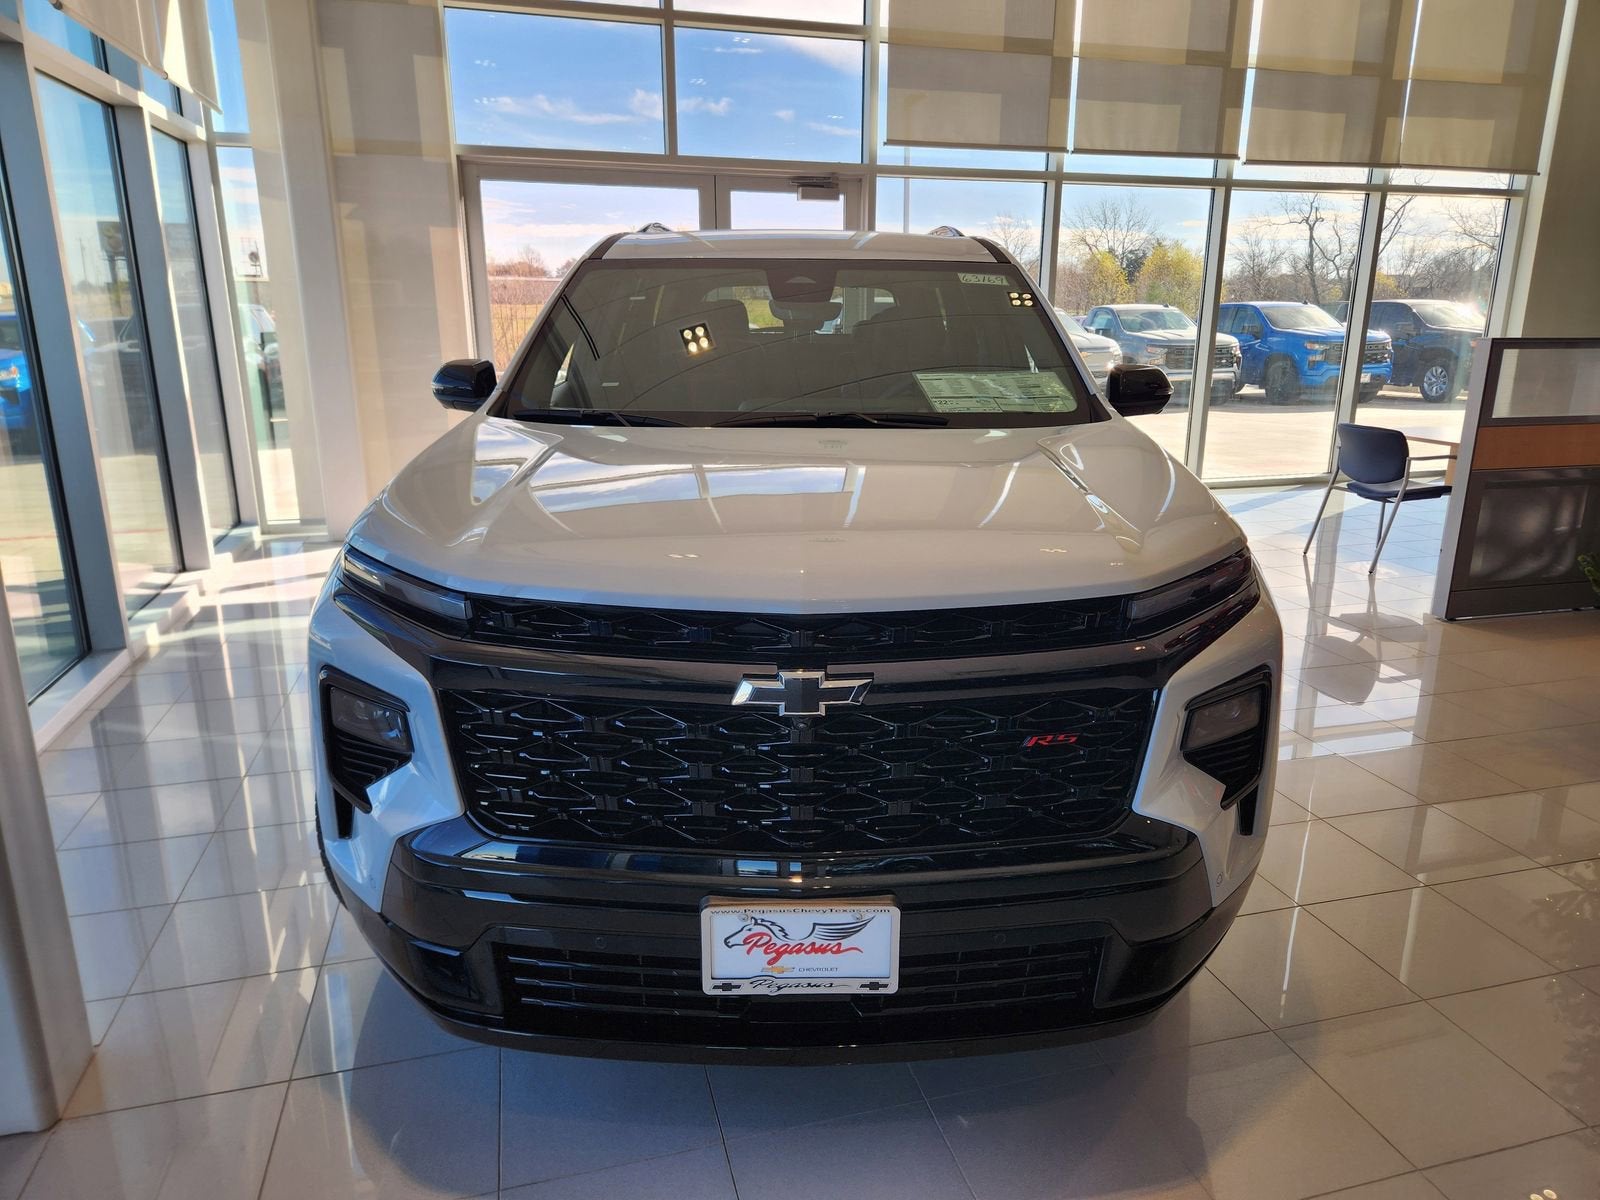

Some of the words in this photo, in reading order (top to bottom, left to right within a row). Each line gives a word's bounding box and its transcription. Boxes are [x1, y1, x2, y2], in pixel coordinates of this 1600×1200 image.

[1023, 734, 1079, 747] RS
[743, 932, 864, 966] Pegasus
[750, 979, 850, 993] Pegasus
